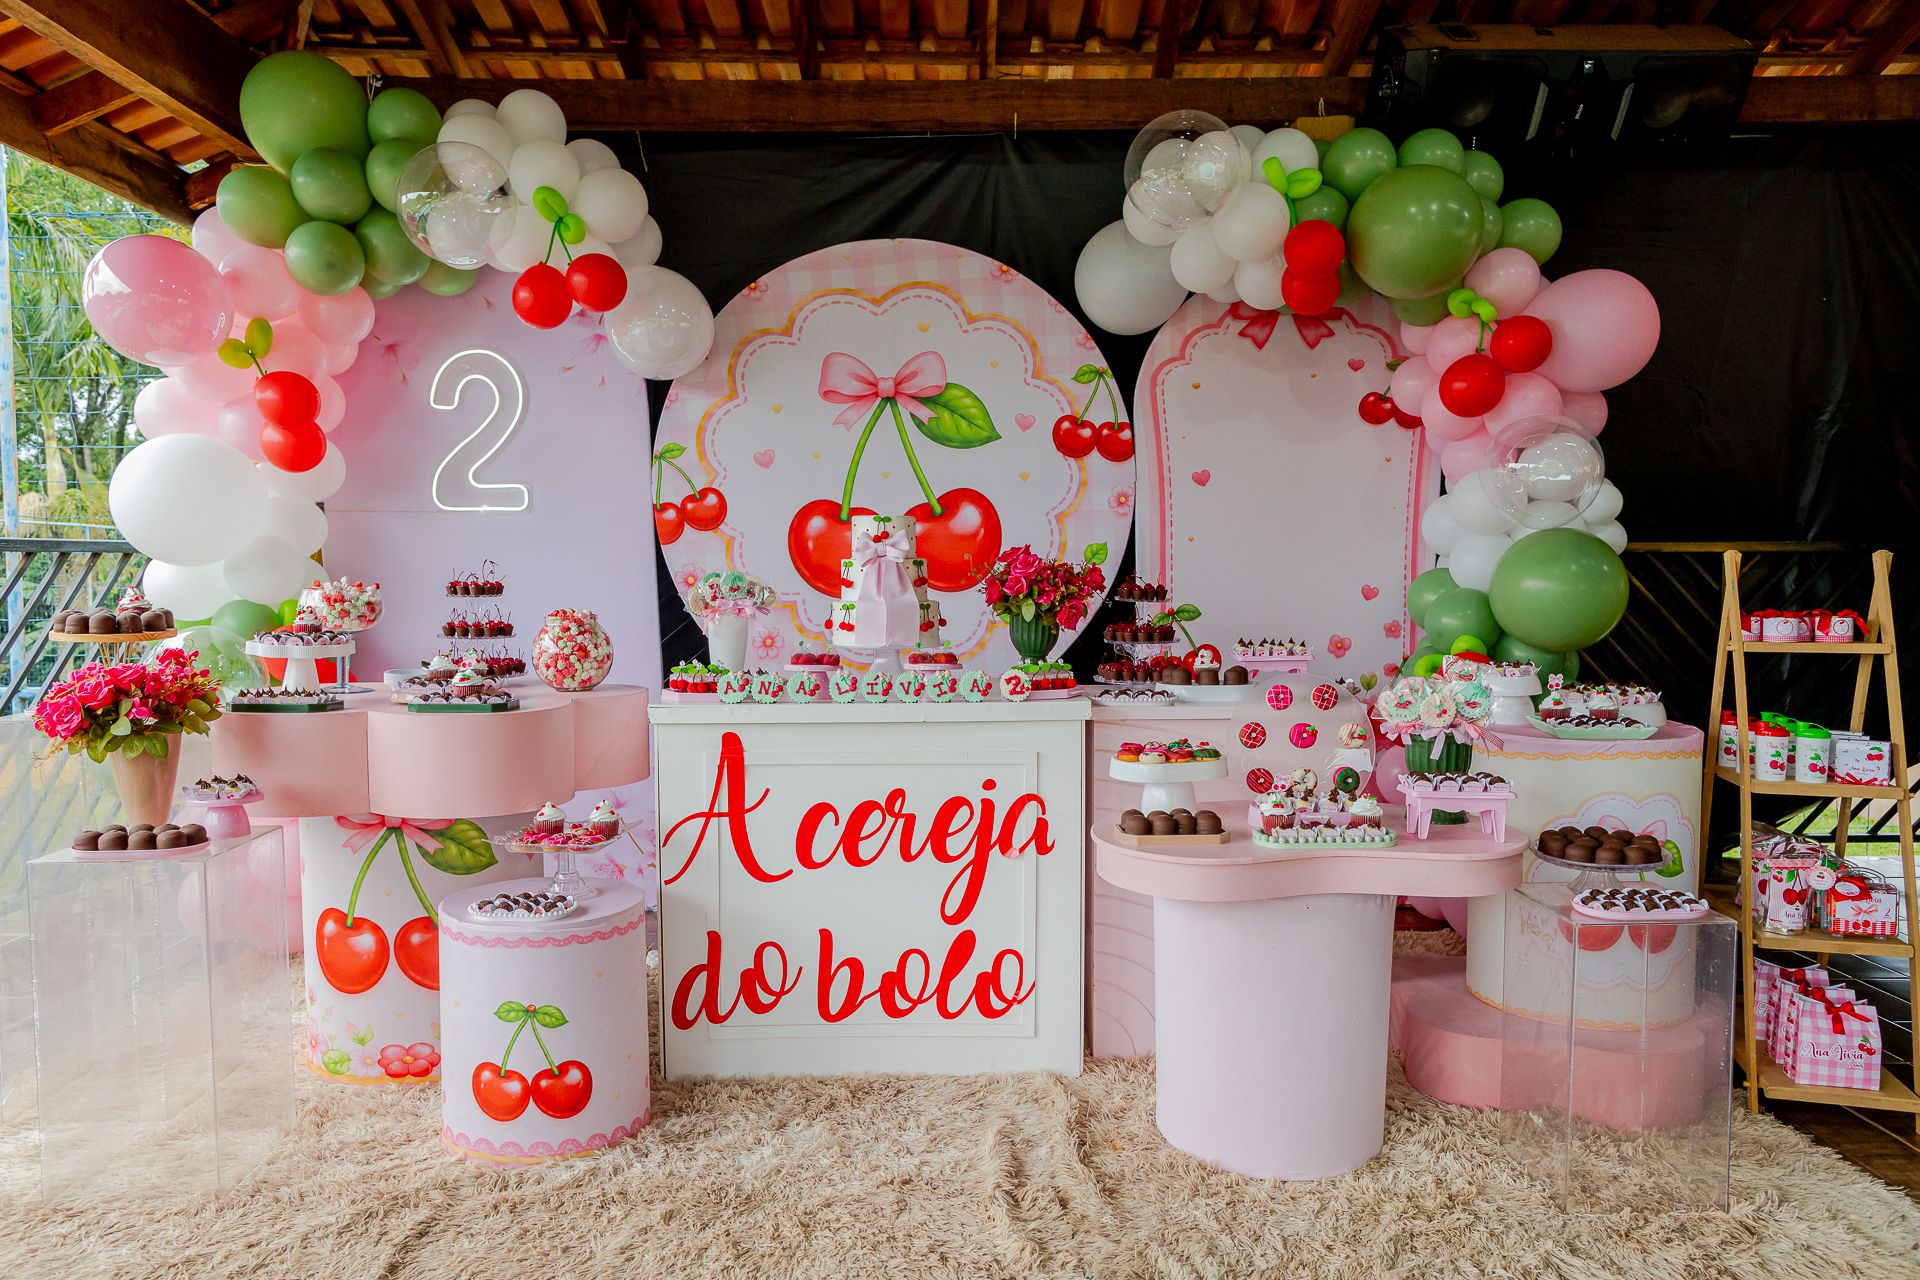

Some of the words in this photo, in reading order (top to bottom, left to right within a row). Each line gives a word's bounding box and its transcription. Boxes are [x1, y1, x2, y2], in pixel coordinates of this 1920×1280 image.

[430, 349, 528, 512] 2
[662, 731, 794, 886] A
[795, 778, 1055, 926] cereja
[671, 930, 803, 1031] do
[817, 928, 1036, 1024] bolo
[1800, 1041, 1829, 1059] Ana
